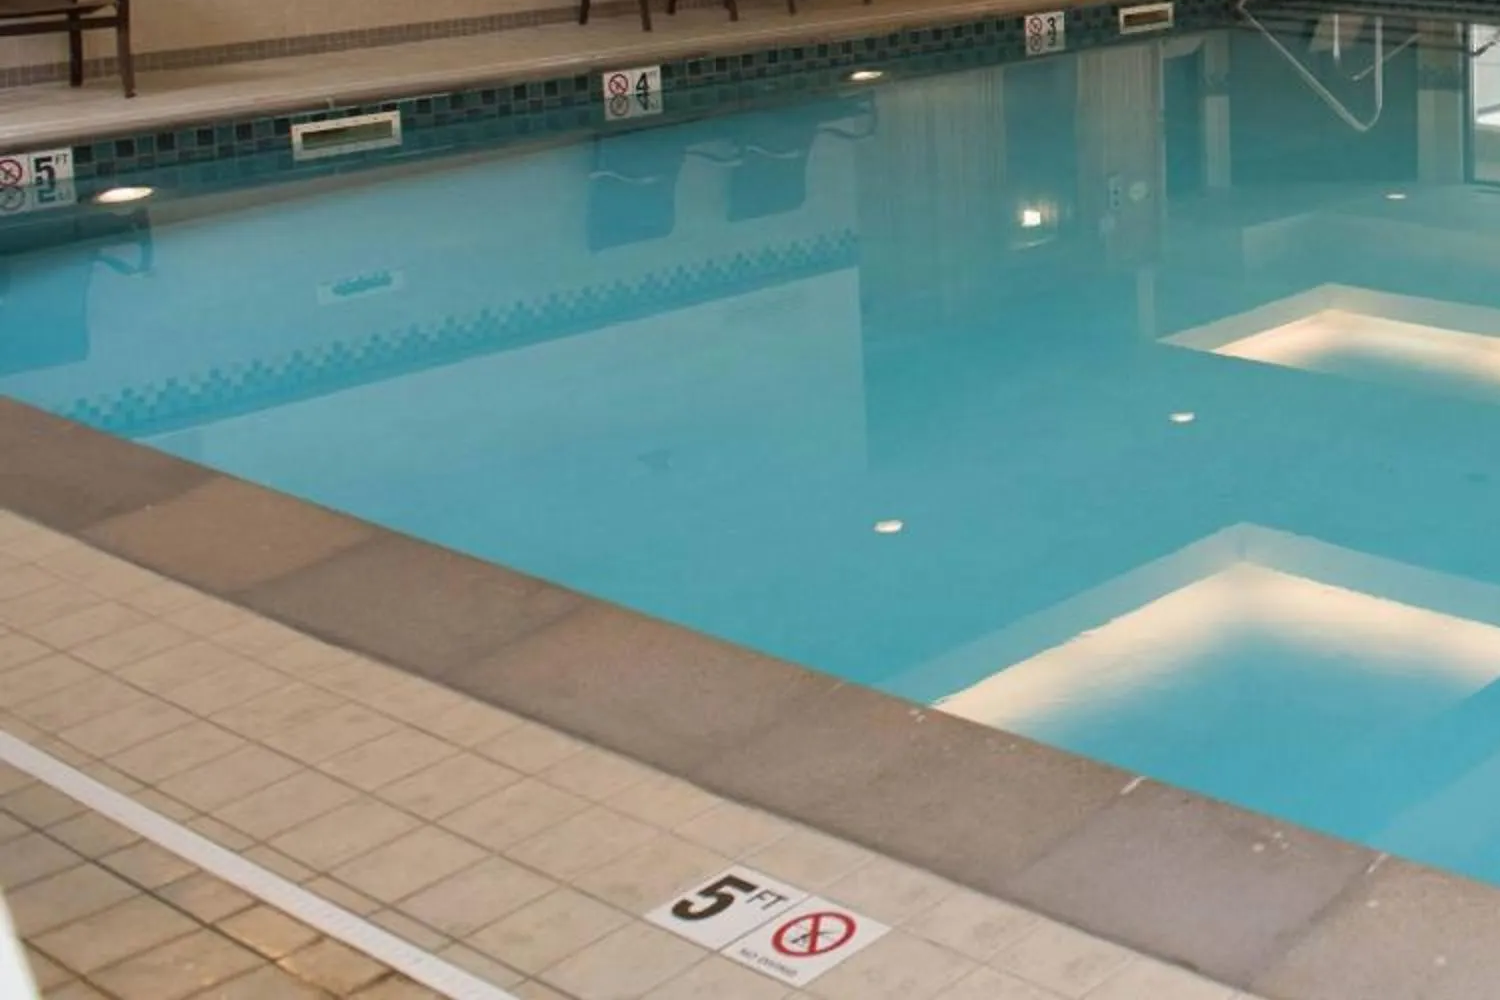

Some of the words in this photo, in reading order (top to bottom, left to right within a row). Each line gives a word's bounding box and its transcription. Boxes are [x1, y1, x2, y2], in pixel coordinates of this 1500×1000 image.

[635, 72, 650, 95] 4
[34, 155, 56, 188] 5
[671, 874, 757, 921] 5
[745, 888, 790, 911] FT
